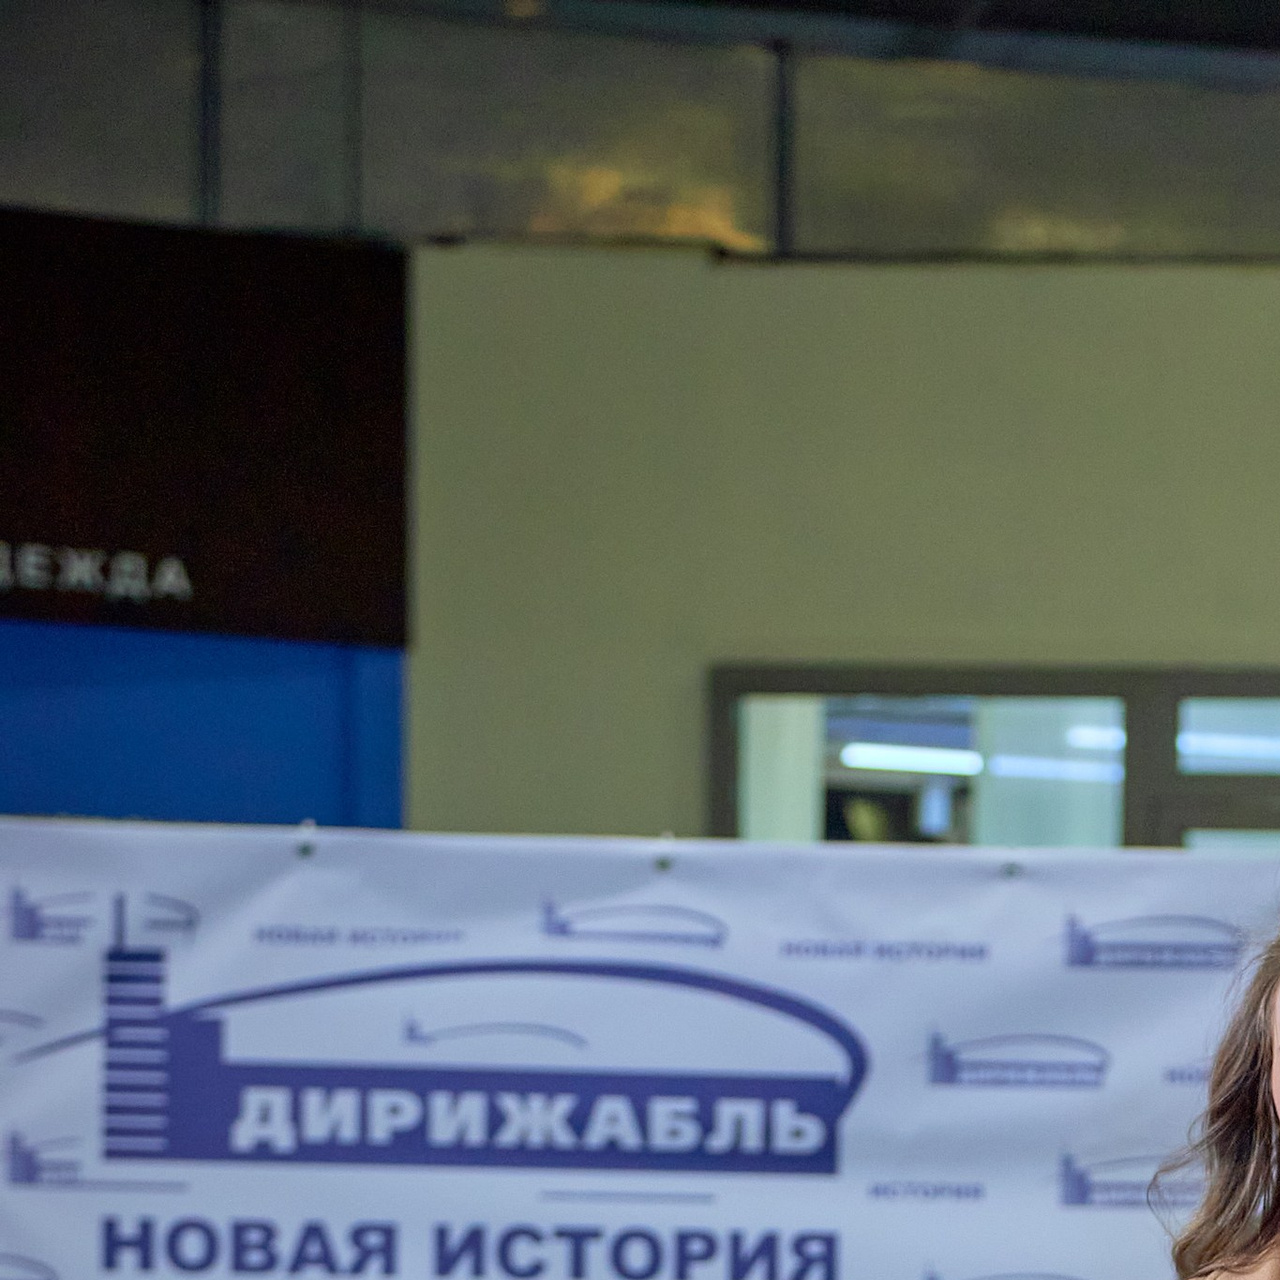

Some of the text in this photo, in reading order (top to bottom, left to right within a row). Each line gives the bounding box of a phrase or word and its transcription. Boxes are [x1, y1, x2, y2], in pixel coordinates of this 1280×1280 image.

[0, 541, 193, 602] ЕЖДА
[229, 1086, 828, 1155] ДИРИЖАБЛЬ
[102, 1216, 398, 1276] НОВАЯ
